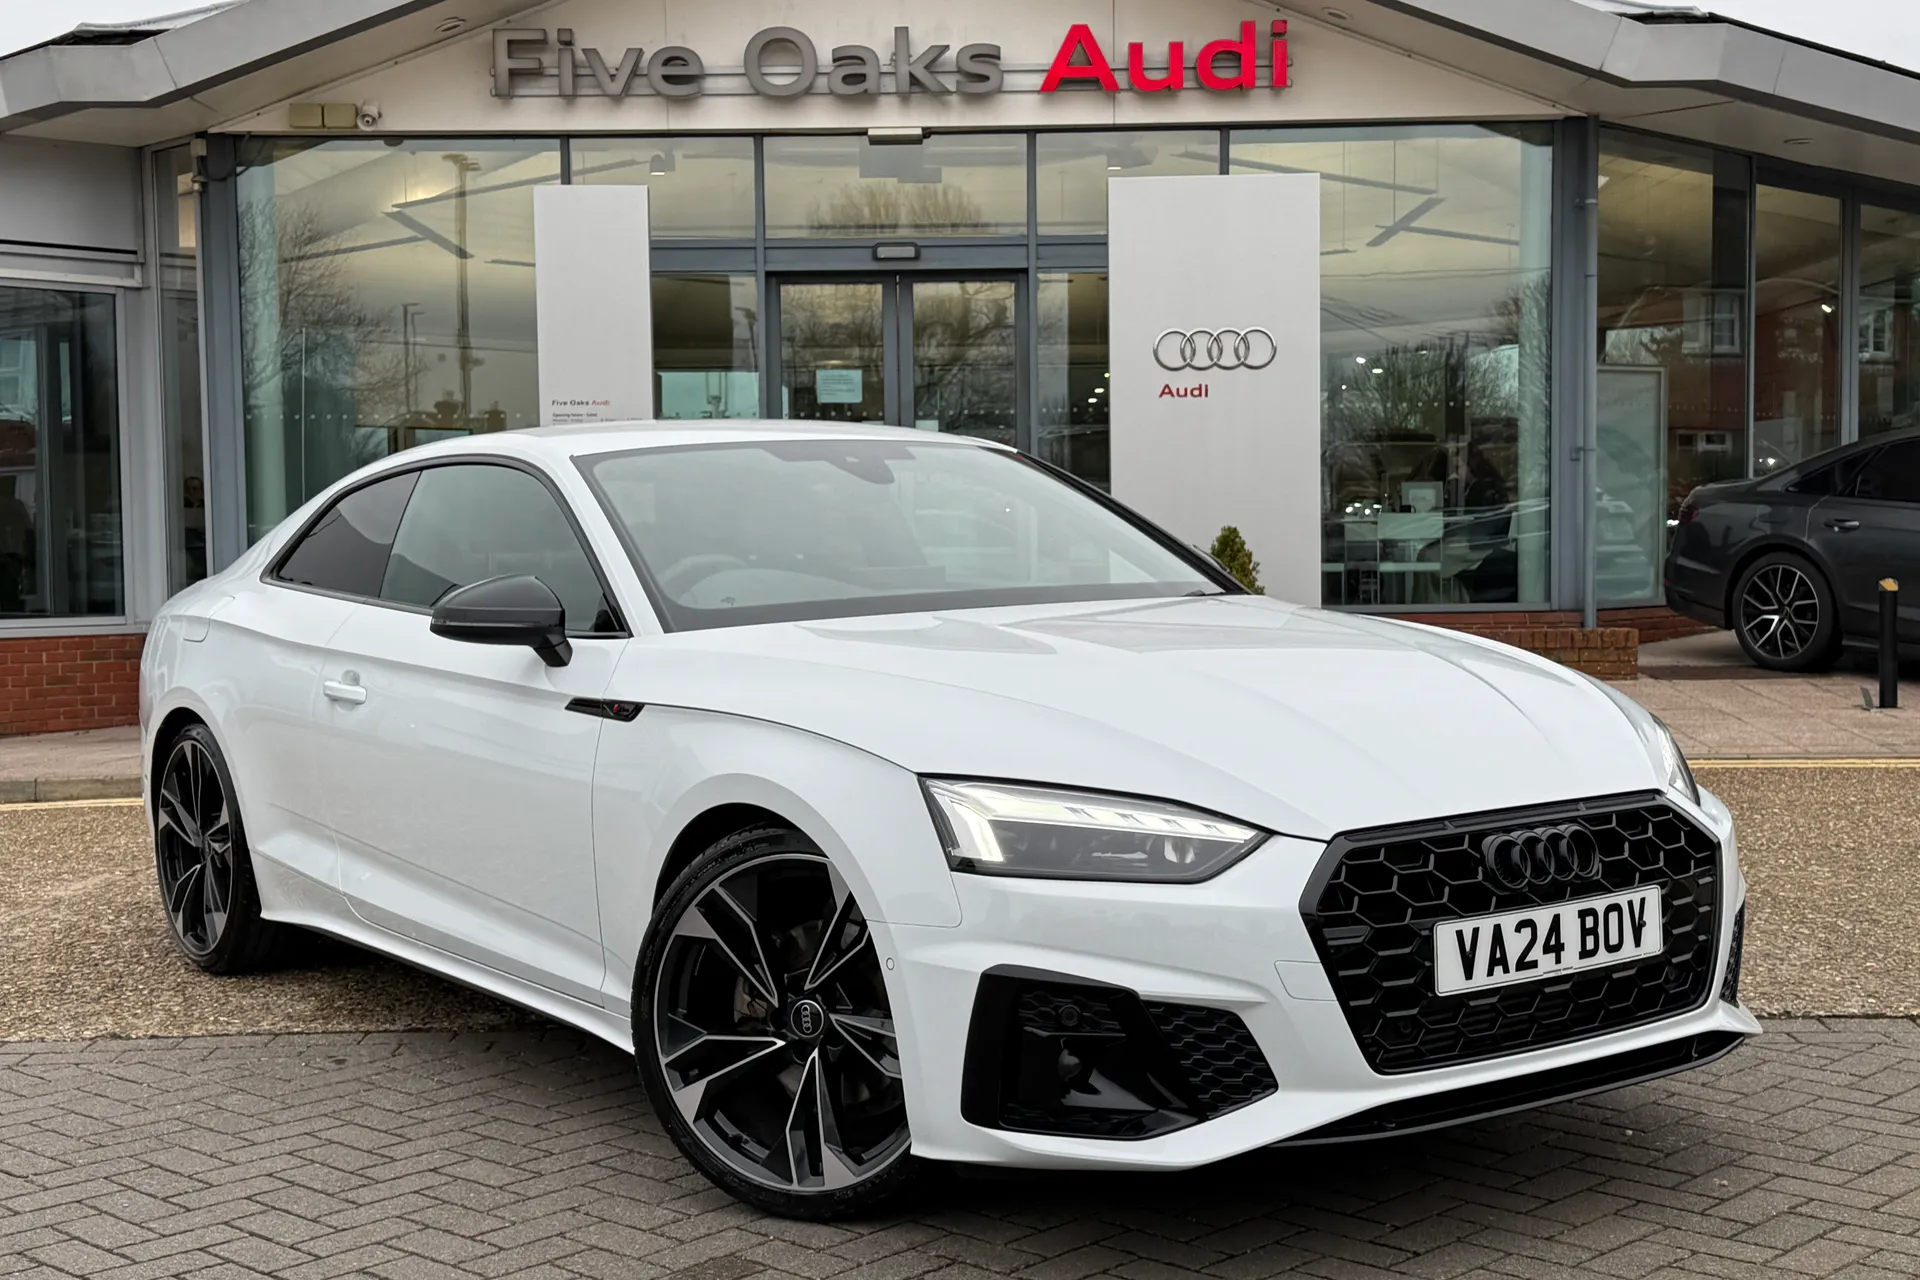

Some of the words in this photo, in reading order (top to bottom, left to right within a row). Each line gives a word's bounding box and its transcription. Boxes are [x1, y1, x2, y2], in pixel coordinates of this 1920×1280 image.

[492, 27, 704, 99] Five
[743, 25, 1004, 98] Oaks
[1039, 19, 1289, 93] Audi
[1158, 383, 1209, 398] Audi
[1455, 913, 1565, 981] VA24
[1577, 896, 1647, 960] BOV
